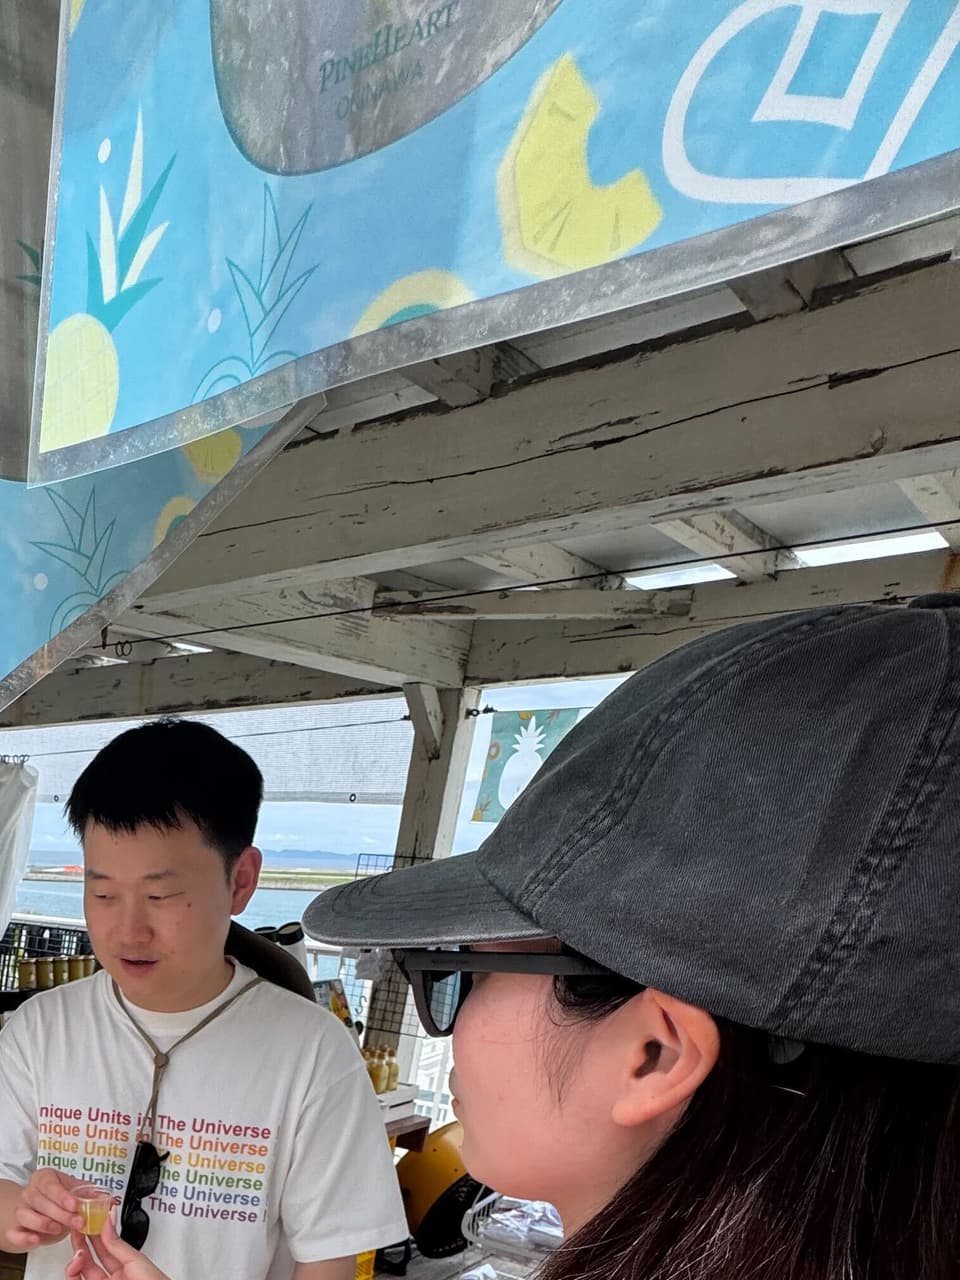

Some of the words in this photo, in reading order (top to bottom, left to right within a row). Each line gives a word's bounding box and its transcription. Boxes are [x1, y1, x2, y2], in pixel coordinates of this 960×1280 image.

[40, 1104, 82, 1122] nique
[88, 1107, 132, 1126] Units
[137, 1113, 153, 1128] in
[158, 1115, 186, 1132] The
[192, 1118, 271, 1139] Universe
[38, 1137, 79, 1155] nique
[84, 1141, 128, 1159] Units
[39, 1121, 80, 1138] nique
[86, 1124, 129, 1142] Units
[156, 1131, 184, 1148] The
[189, 1135, 269, 1157] Universe
[38, 1153, 77, 1170] nique
[82, 1157, 126, 1175] Units
[188, 1152, 266, 1174] Universe
[160, 1164, 180, 1181] he
[186, 1169, 263, 1191] Universe
[160, 1181, 178, 1198] he
[183, 1185, 261, 1207] Universe
[149, 1196, 176, 1214] The
[181, 1202, 258, 1223] Universe
